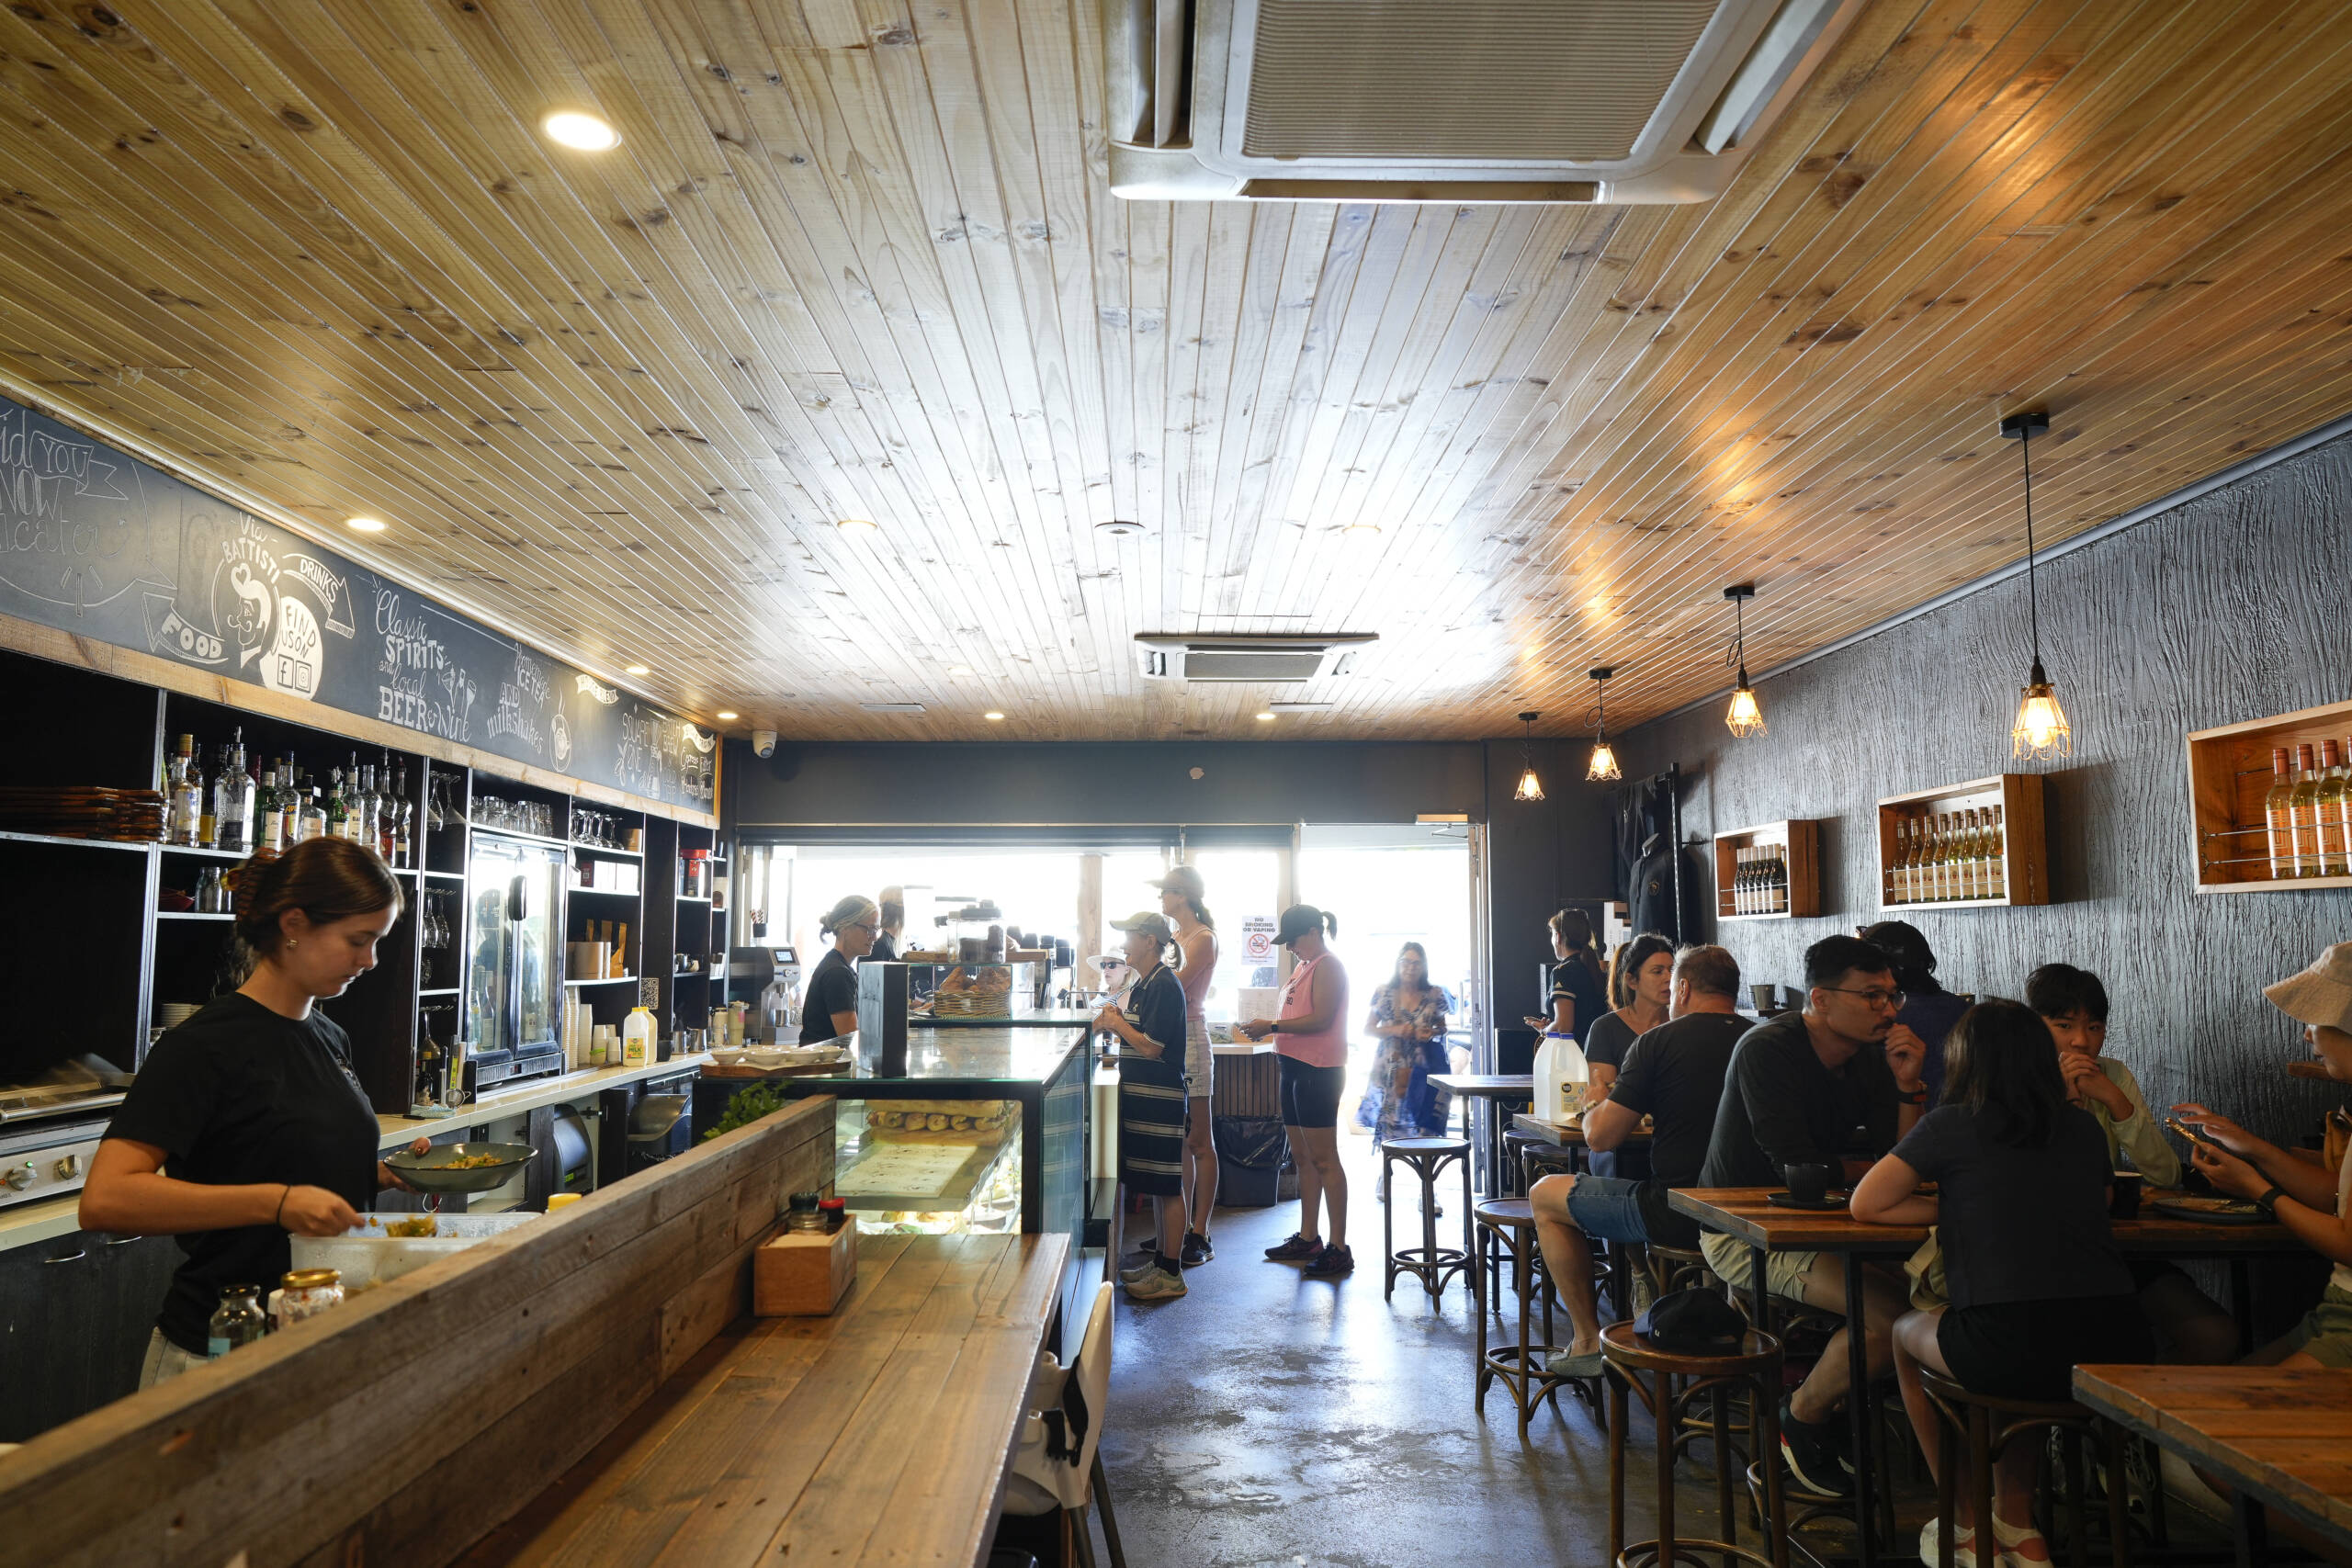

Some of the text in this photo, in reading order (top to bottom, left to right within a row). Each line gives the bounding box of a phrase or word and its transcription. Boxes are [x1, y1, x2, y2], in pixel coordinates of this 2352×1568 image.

[0, 410, 32, 468] id
[39, 437, 88, 477] YOU
[239, 511, 268, 543] Via
[221, 537, 281, 584] BATTISTI
[300, 558, 339, 604] DRINKS
[161, 613, 222, 659] FOOD
[286, 604, 316, 648] FIND
[375, 590, 429, 645] Classic
[385, 634, 445, 671] SPIRITS
[390, 662, 428, 700] local
[499, 682, 521, 708] AND
[378, 685, 429, 733] BEER
[435, 701, 472, 742] Wine
[486, 702, 544, 755] milkshakes
